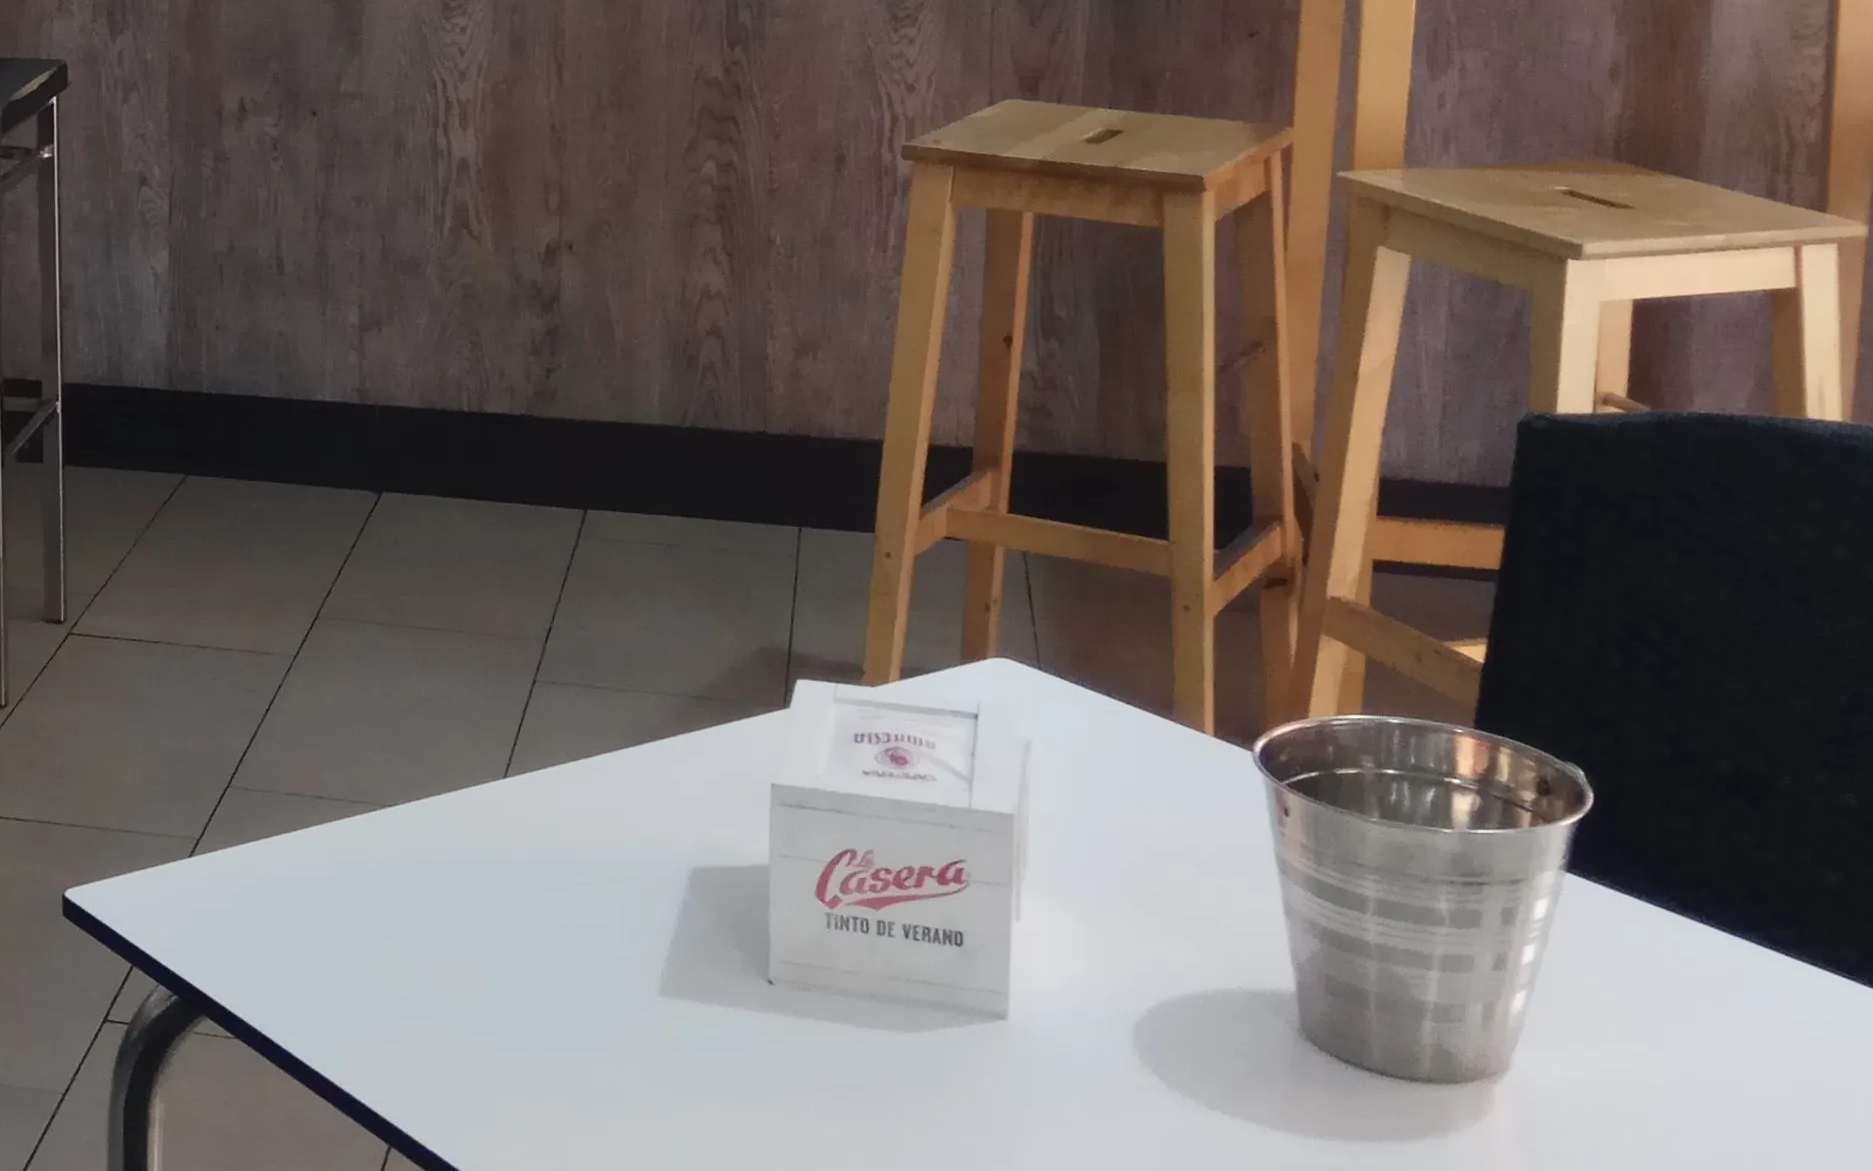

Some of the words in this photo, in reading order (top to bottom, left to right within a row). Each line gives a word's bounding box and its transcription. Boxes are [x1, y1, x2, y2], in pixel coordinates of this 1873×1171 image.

[814, 847, 971, 911] Casera
[824, 912, 870, 934] TINTO
[877, 920, 896, 939] DE
[902, 923, 964, 947] VERANO
